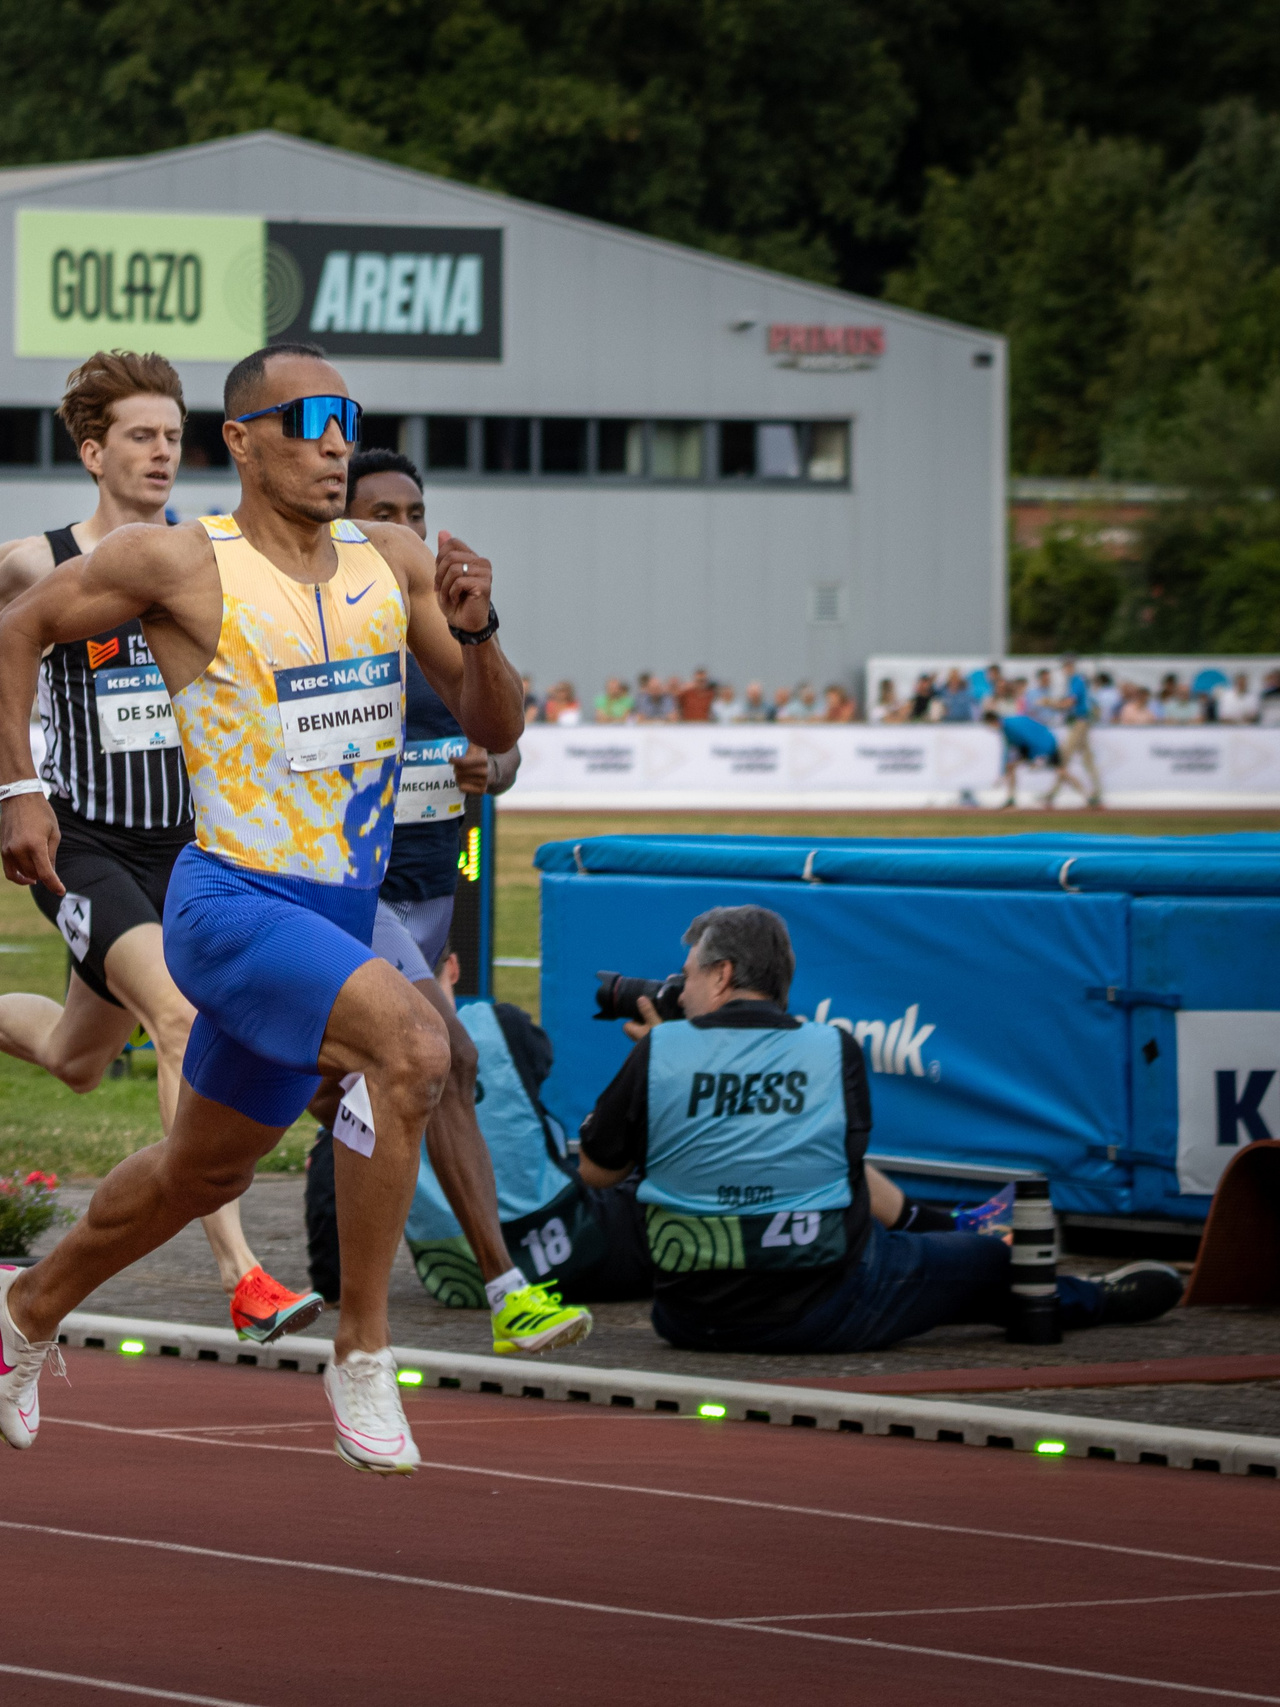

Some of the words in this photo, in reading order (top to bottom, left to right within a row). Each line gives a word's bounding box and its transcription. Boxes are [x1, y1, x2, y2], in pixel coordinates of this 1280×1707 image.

[52, 248, 204, 325] GOLAZO
[310, 250, 485, 335] ARENA
[117, 706, 141, 722] DE
[297, 701, 393, 733] BENMAHDI
[687, 1071, 808, 1119] PRESS
[521, 1217, 572, 1276] 18
[761, 1210, 821, 1248] 25
